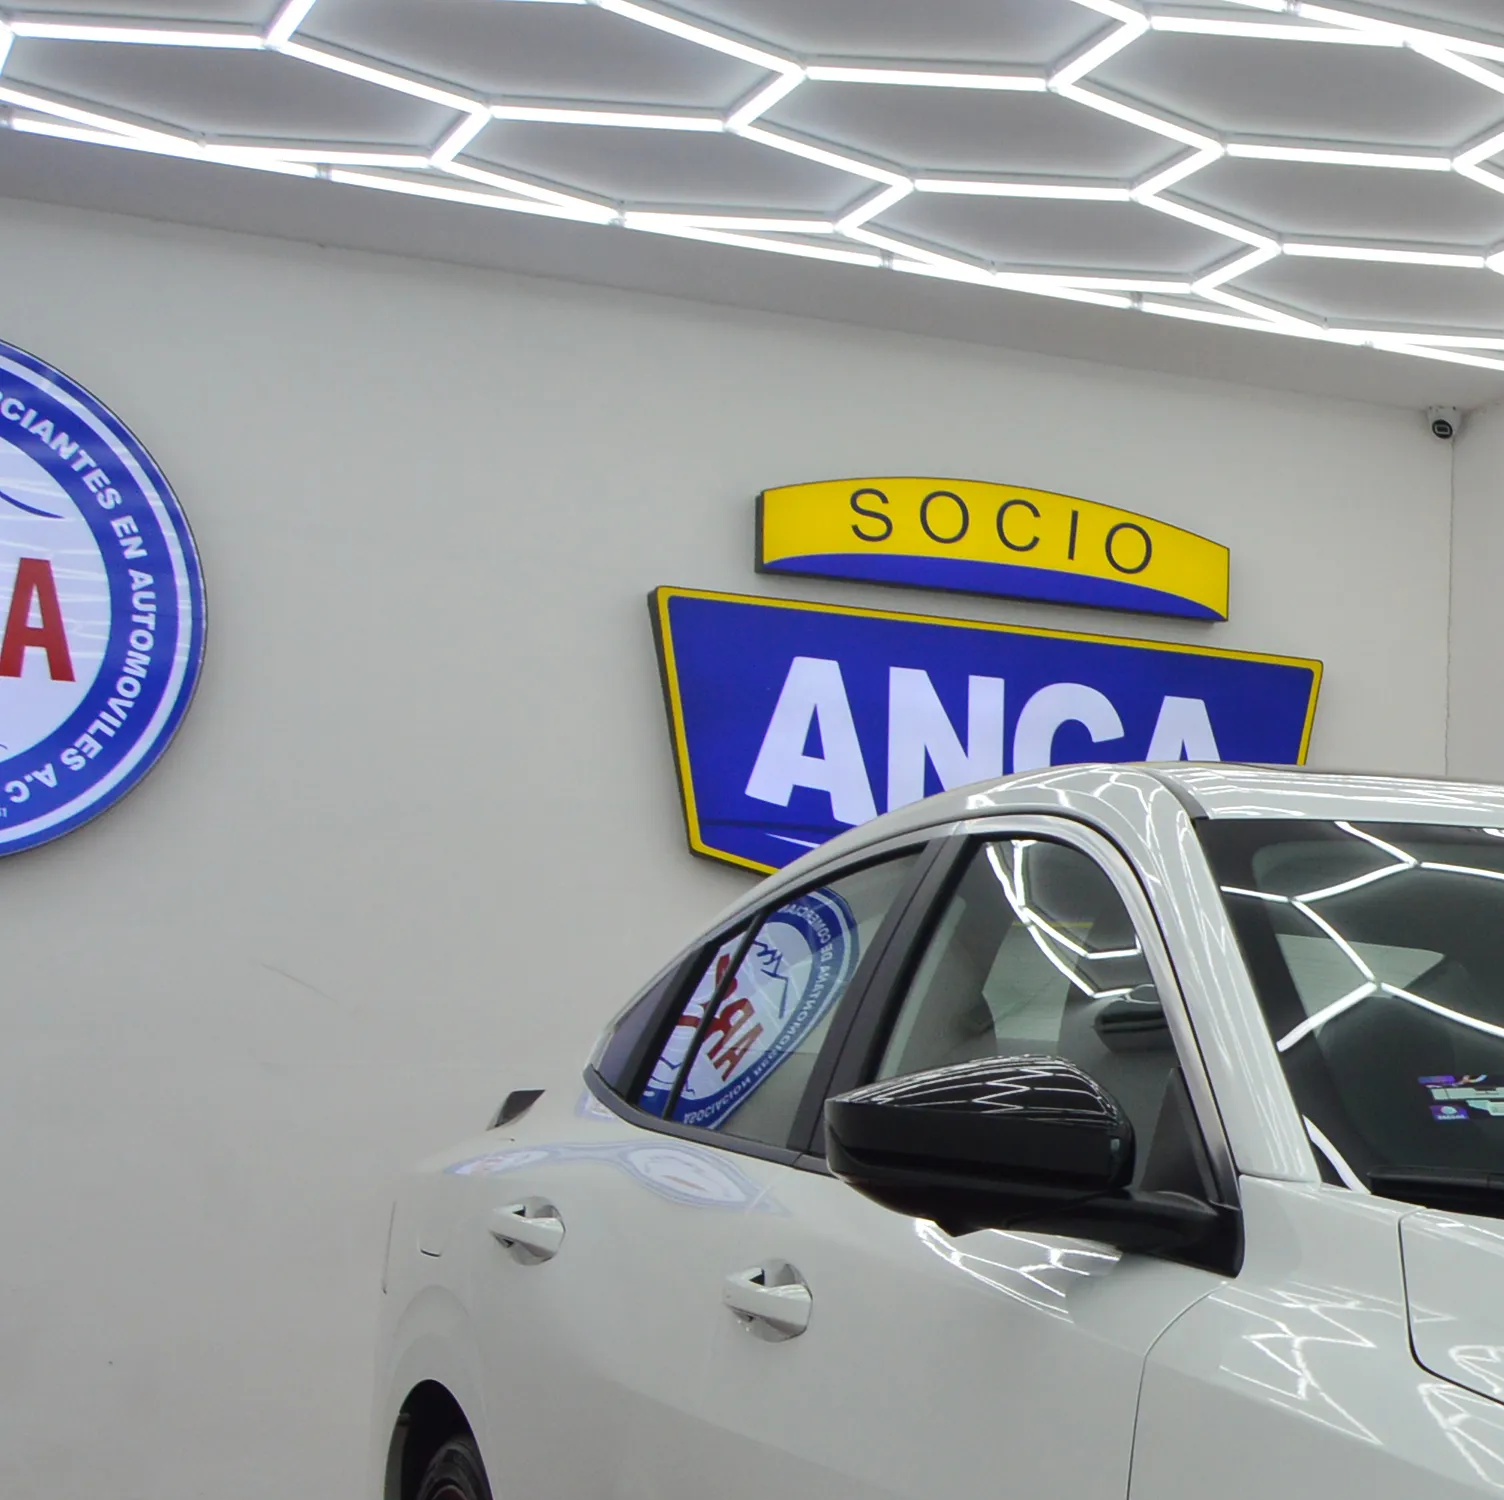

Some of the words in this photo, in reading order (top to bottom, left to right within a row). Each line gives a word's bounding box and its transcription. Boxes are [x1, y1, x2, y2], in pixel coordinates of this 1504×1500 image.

[0, 391, 122, 510] CIANTES
[110, 515, 148, 560] EN
[850, 487, 1153, 575] SOCIO
[60, 568, 157, 772] AUTOMOVILES
